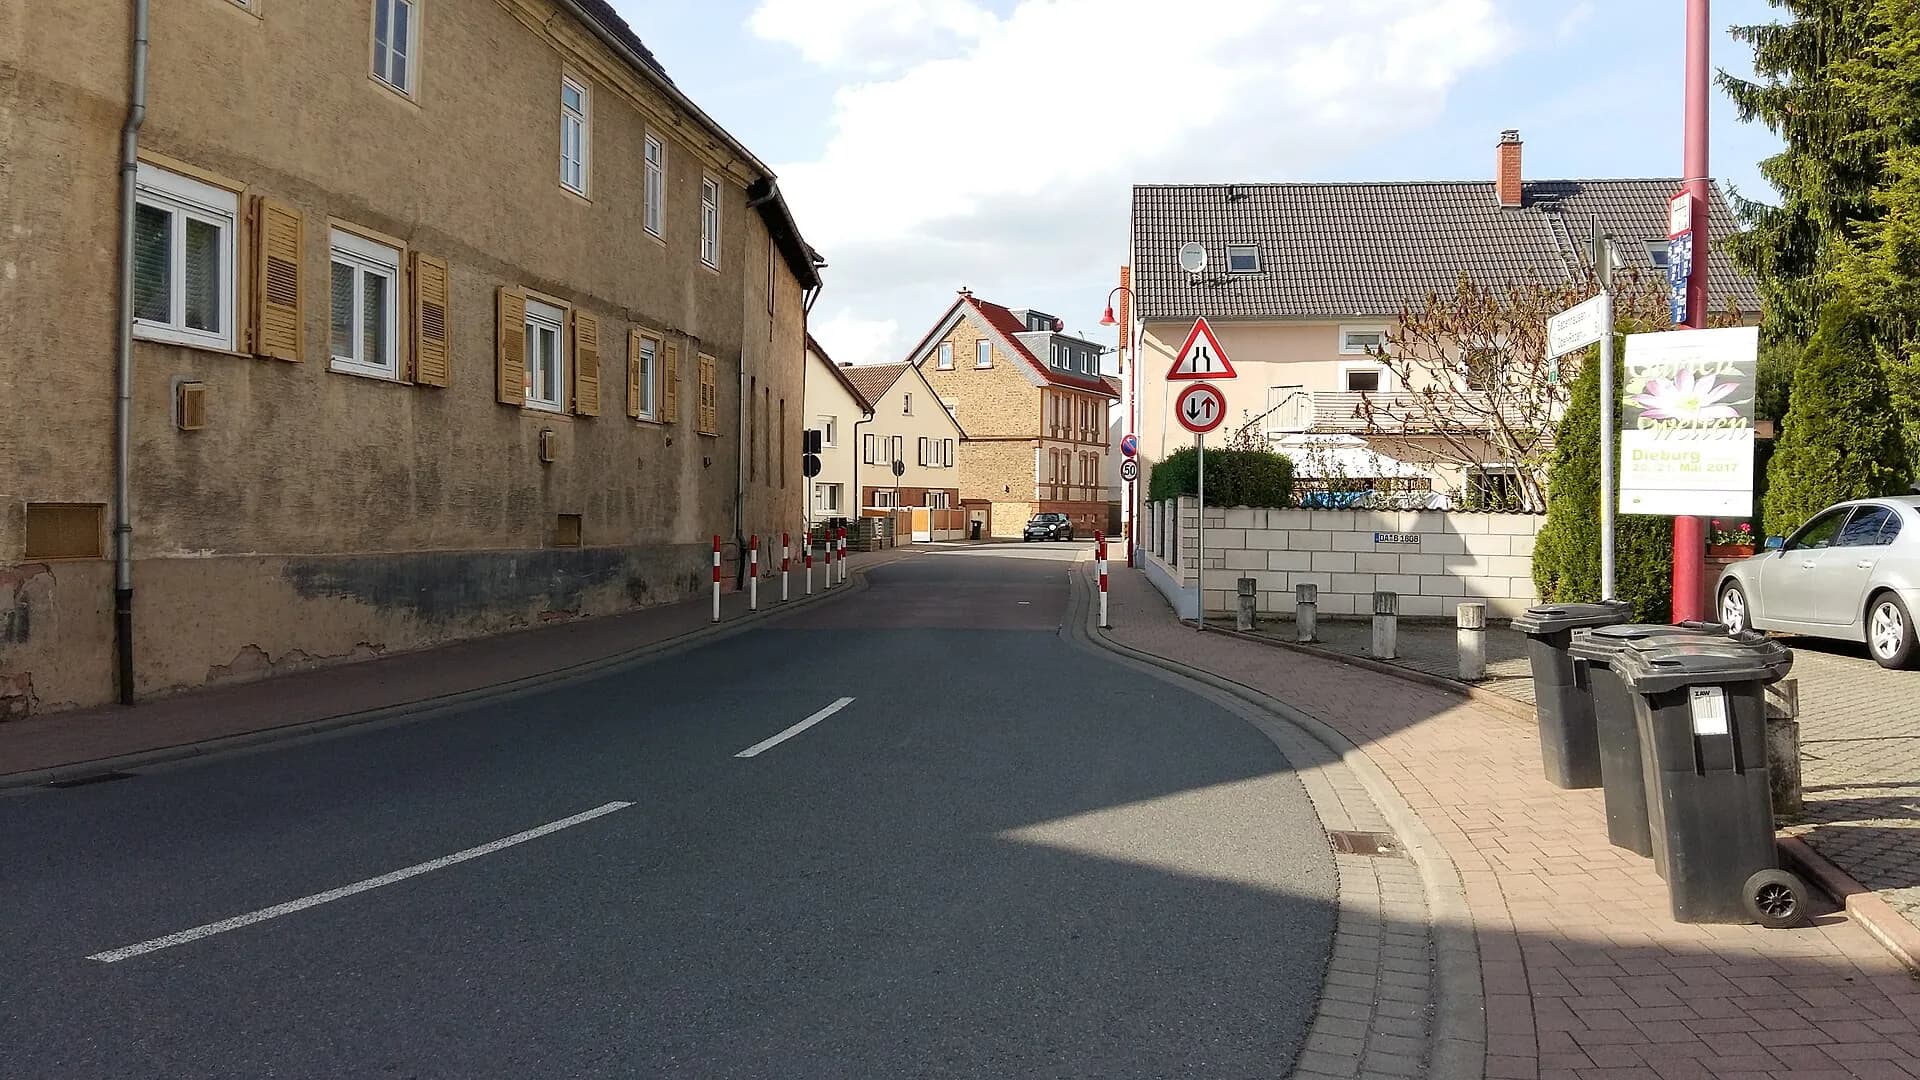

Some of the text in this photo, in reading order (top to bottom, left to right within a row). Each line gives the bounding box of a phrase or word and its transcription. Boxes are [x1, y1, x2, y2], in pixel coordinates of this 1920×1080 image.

[1632, 448, 1701, 463] Dieburg
[1124, 464, 1135, 475] 50
[1680, 463, 1701, 472] Mai
[1707, 463, 1739, 472] 2017
